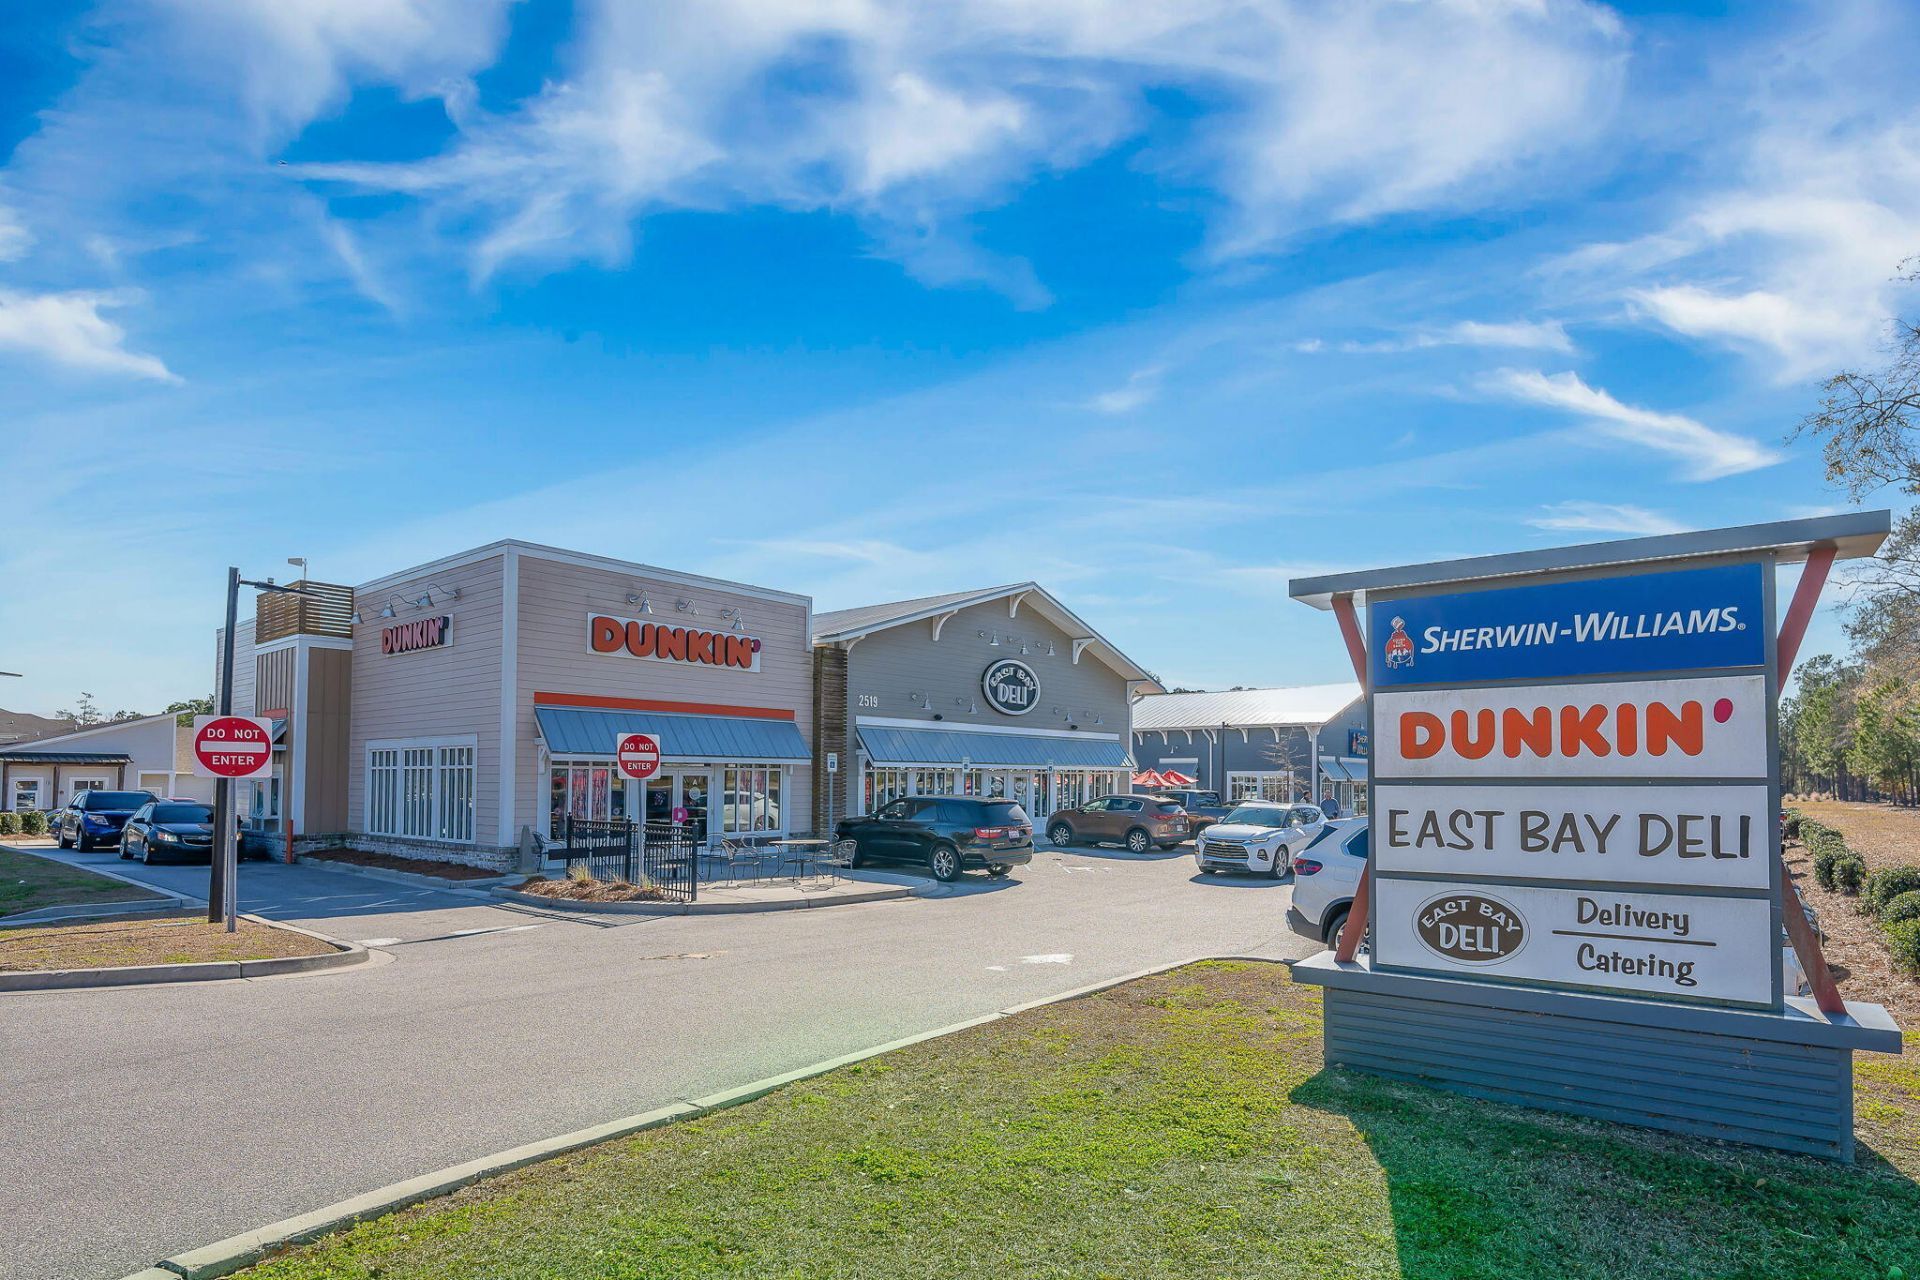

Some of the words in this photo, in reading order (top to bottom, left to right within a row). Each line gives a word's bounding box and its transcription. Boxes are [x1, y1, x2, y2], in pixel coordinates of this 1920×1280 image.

[382, 616, 444, 654] DUNKIN'
[591, 616, 762, 669] DUNKIN'
[990, 667, 1015, 687] EAST
[1016, 669, 1036, 691] BAY
[997, 682, 1027, 707] DELI
[858, 694, 878, 708] 2519
[207, 728, 226, 739] DO
[234, 729, 260, 740] NOT
[1400, 697, 1734, 760] DUNKIN'
[212, 755, 255, 766] ENTER
[624, 742, 635, 751] DO
[639, 743, 654, 751] NOT
[627, 762, 652, 771] ENTER
[1388, 809, 1505, 850] EAST
[1520, 810, 1620, 854] BAY
[1638, 813, 1751, 859] DELI
[1421, 899, 1470, 929] EAST
[1479, 902, 1521, 933] BAY
[1577, 897, 1689, 936] Delivery
[1438, 922, 1499, 953] DELI
[1577, 942, 1698, 987] Catering
